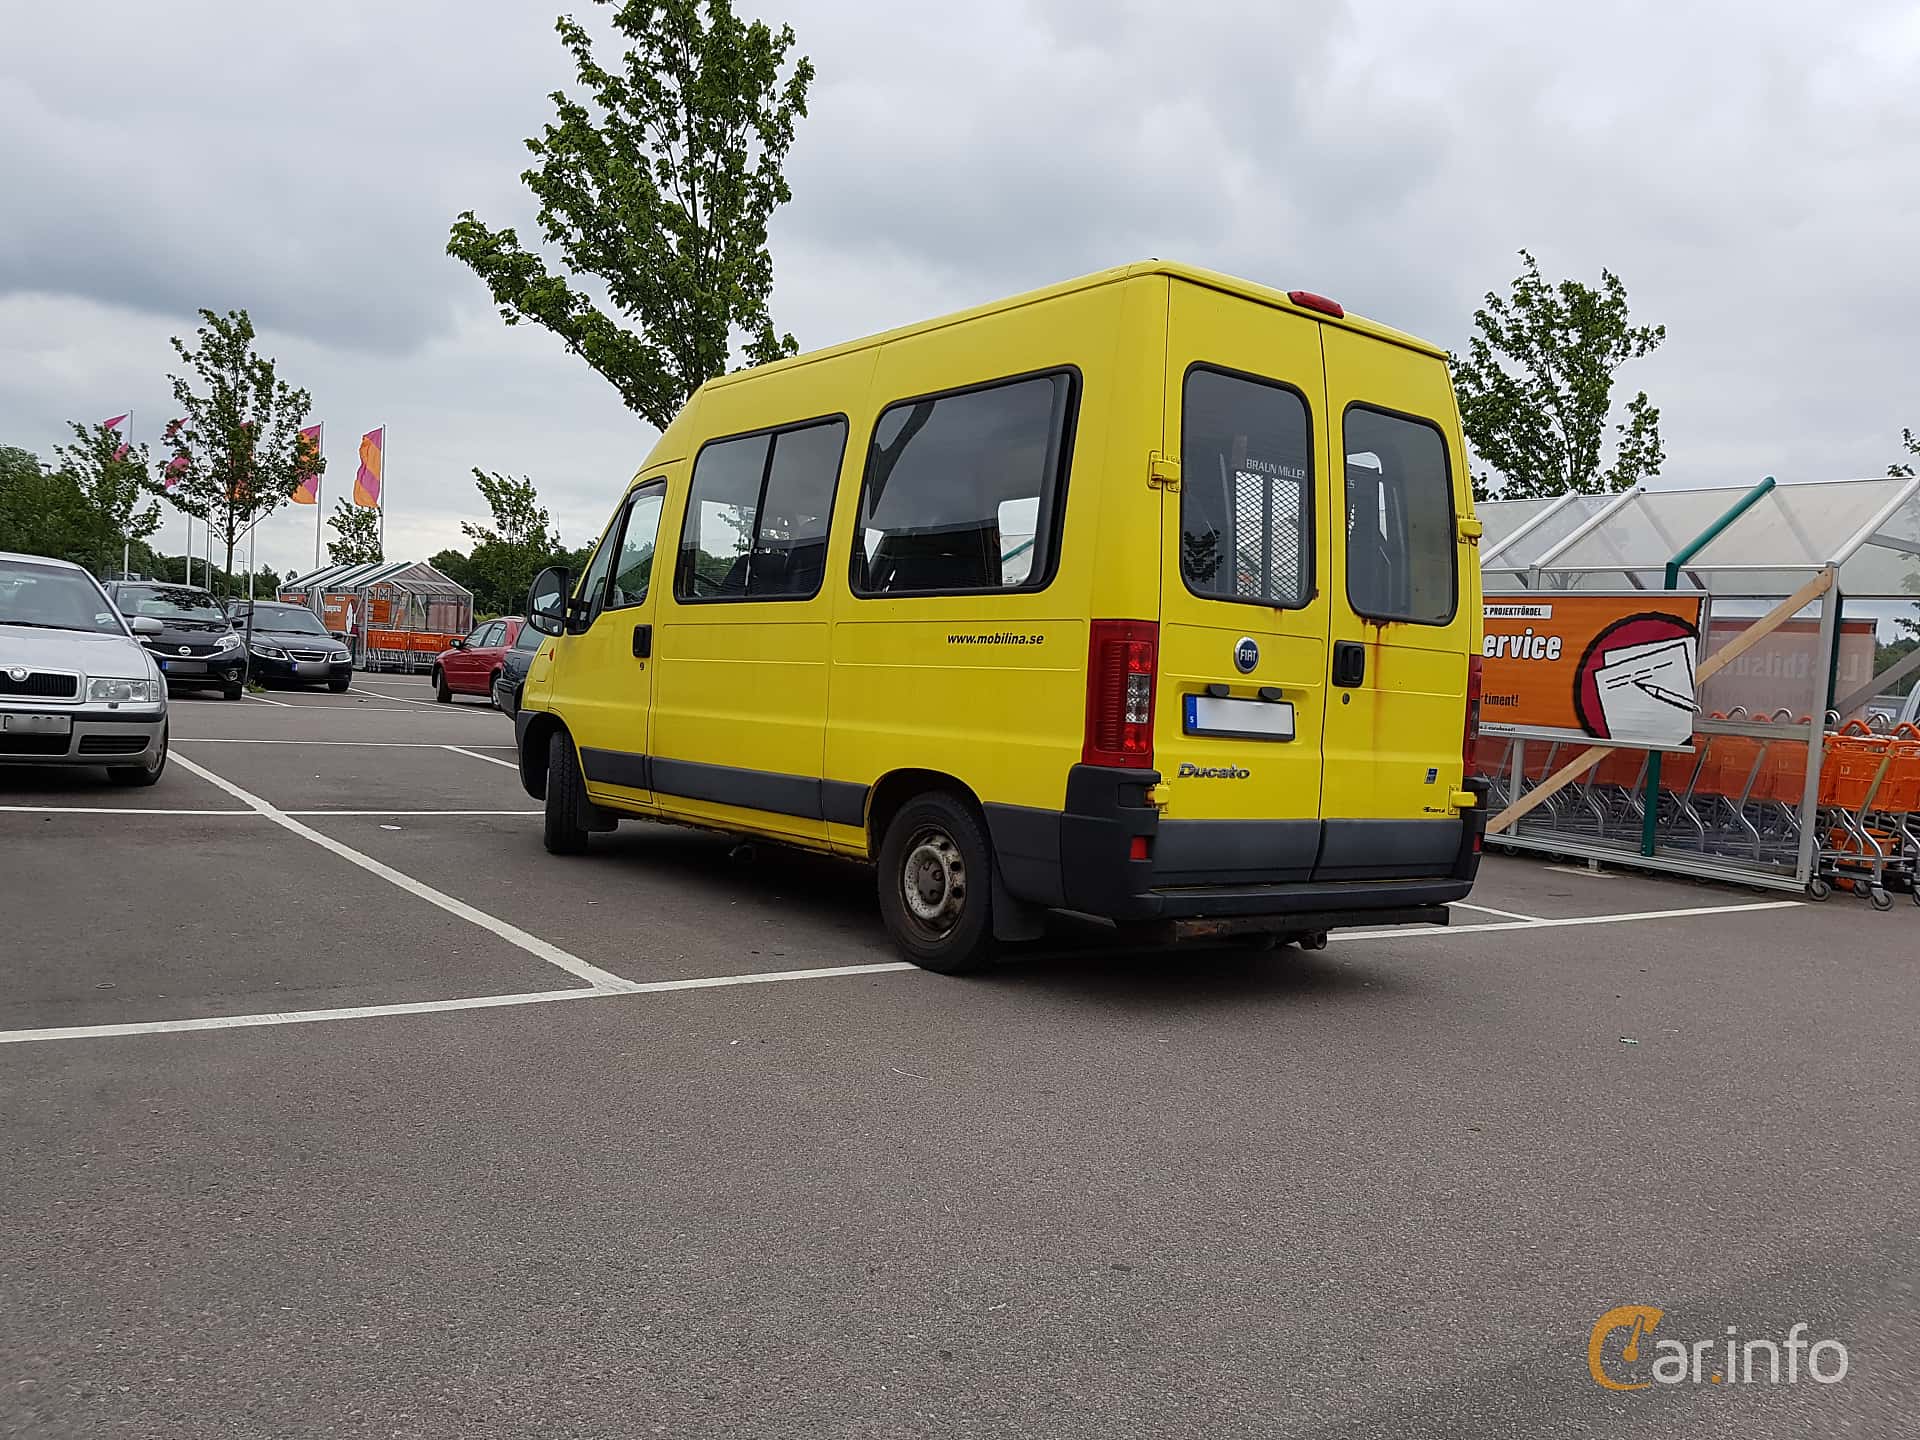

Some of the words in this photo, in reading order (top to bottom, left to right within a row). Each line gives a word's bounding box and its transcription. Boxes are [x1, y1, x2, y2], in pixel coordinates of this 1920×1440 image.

[1489, 605, 1542, 616] PROJEKTFÖRDEL
[947, 632, 1044, 645] www.mobilina.se
[1240, 648, 1257, 661] FIAT
[1178, 762, 1251, 780] Ducato
